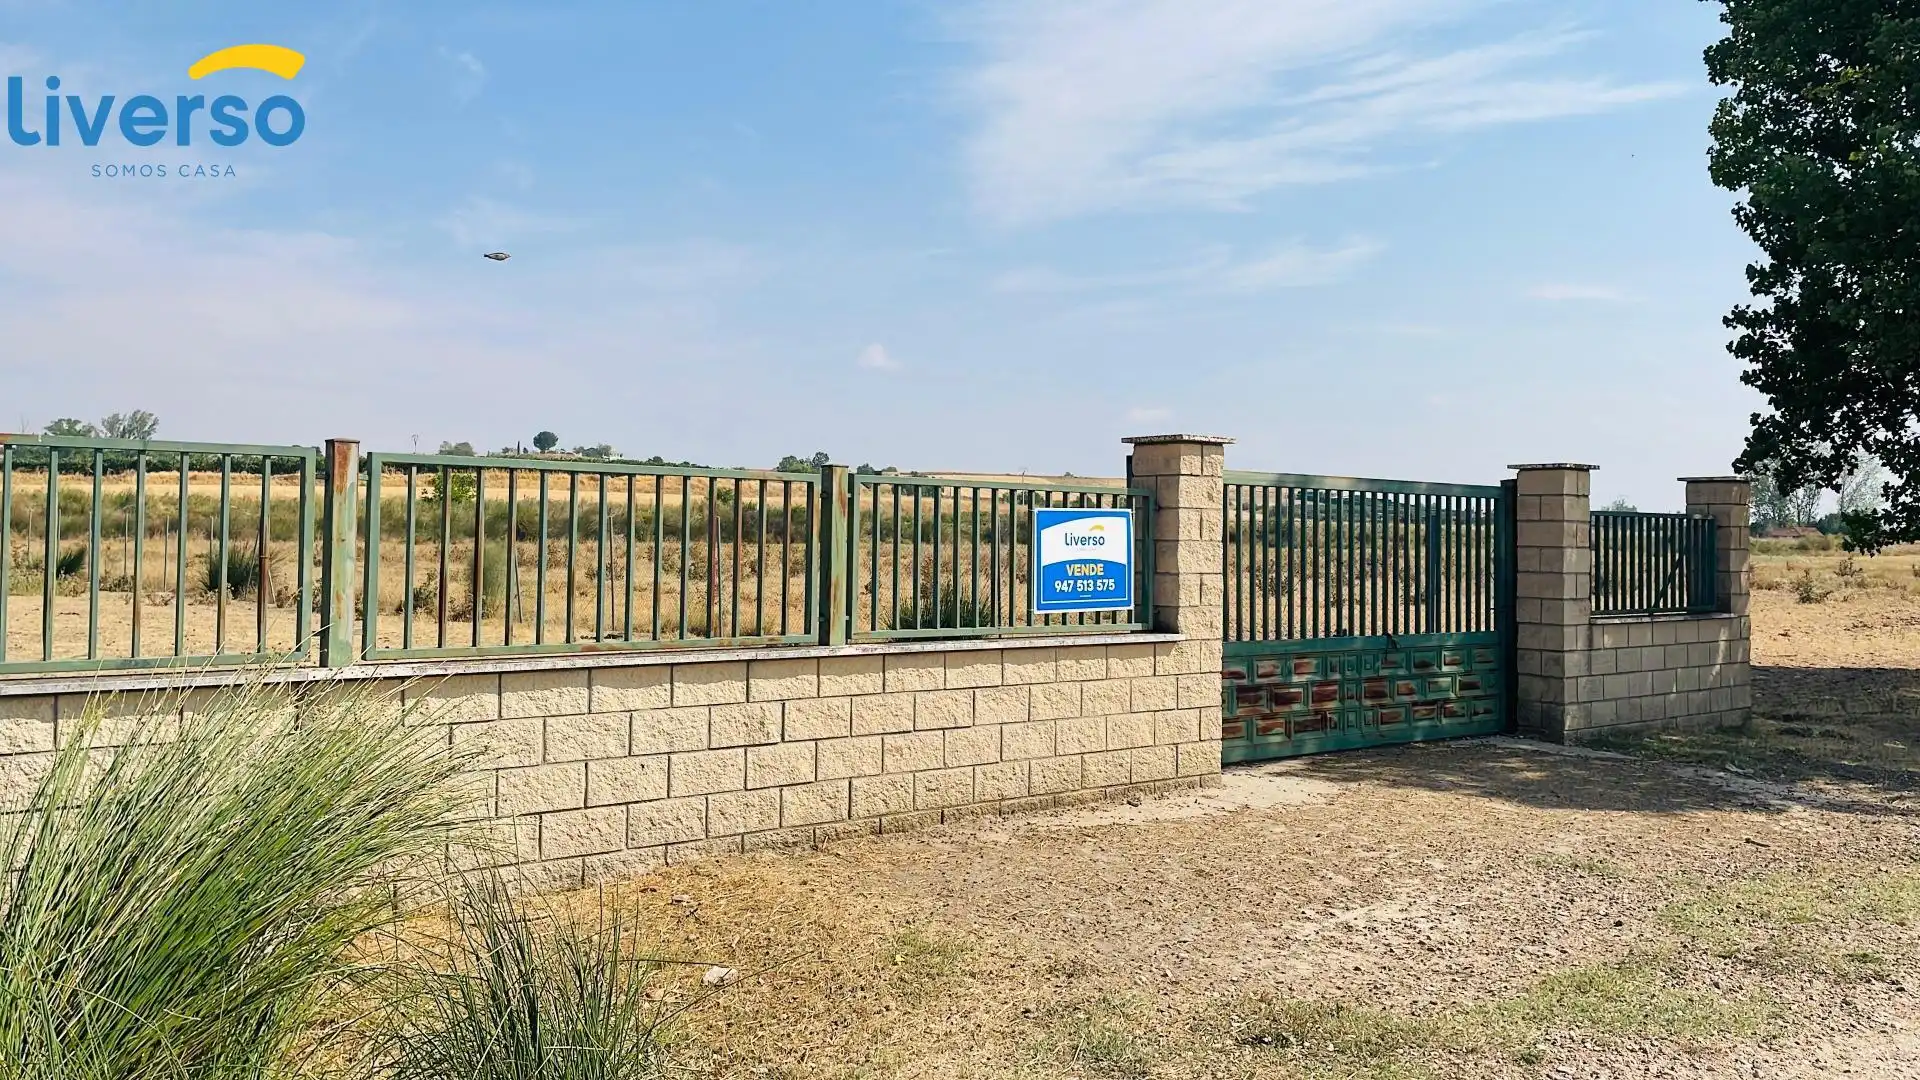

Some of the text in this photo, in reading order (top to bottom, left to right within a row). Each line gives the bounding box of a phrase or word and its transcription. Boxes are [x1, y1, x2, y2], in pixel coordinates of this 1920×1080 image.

[1066, 563, 1104, 576] VENDE
[1054, 578, 1115, 592] 947 513 575
